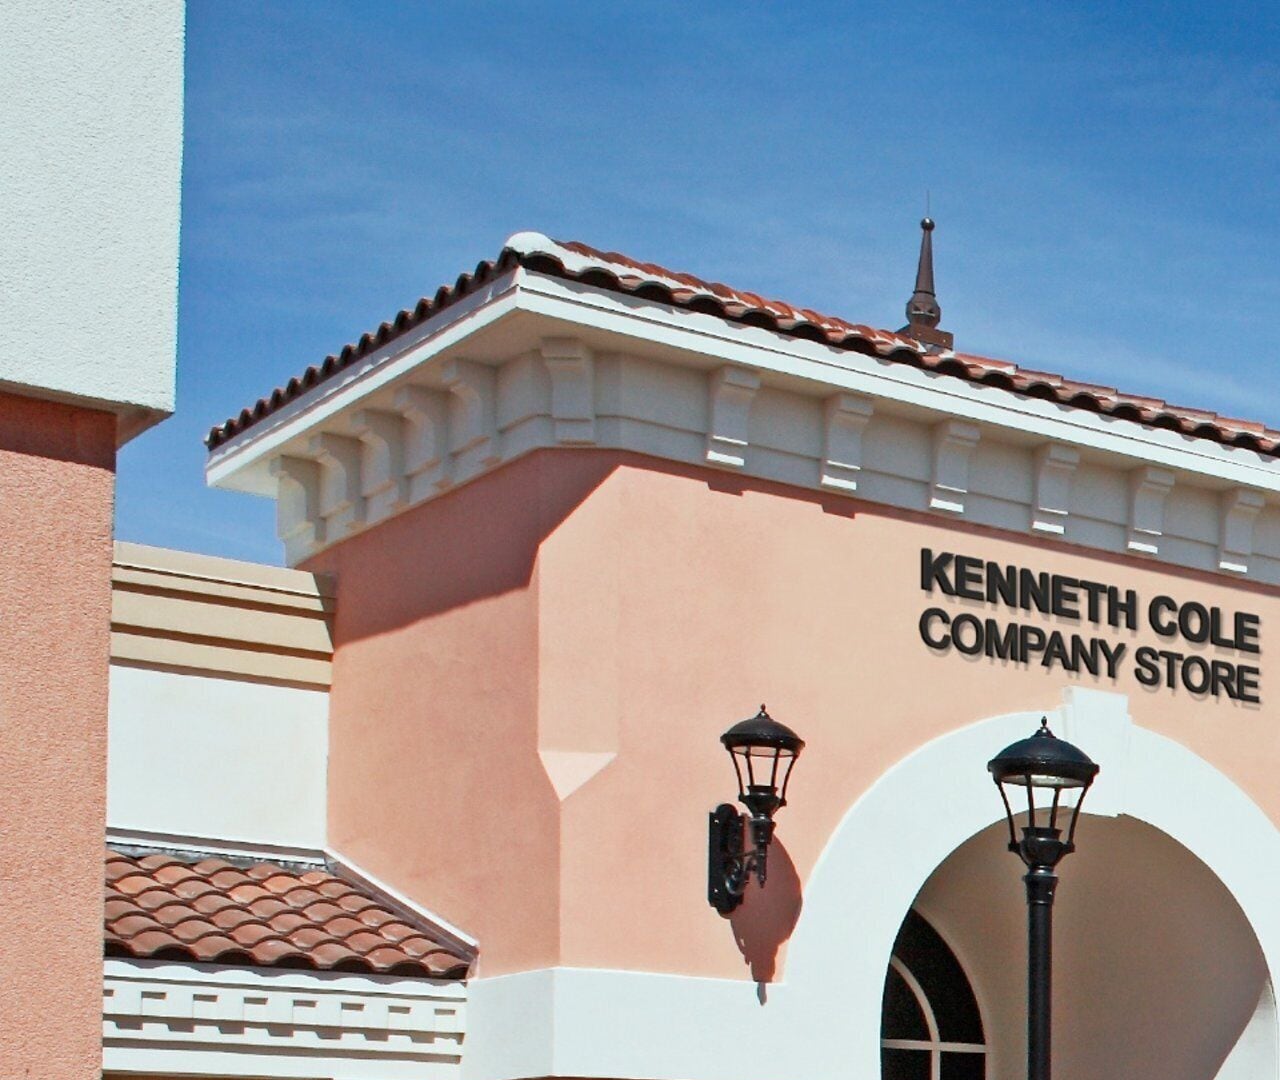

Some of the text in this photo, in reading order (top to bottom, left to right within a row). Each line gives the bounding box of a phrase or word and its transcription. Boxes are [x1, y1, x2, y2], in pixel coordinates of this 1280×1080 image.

[921, 548, 1261, 654] KENNETH COLE
[918, 606, 1262, 704] COMPANY STORE
